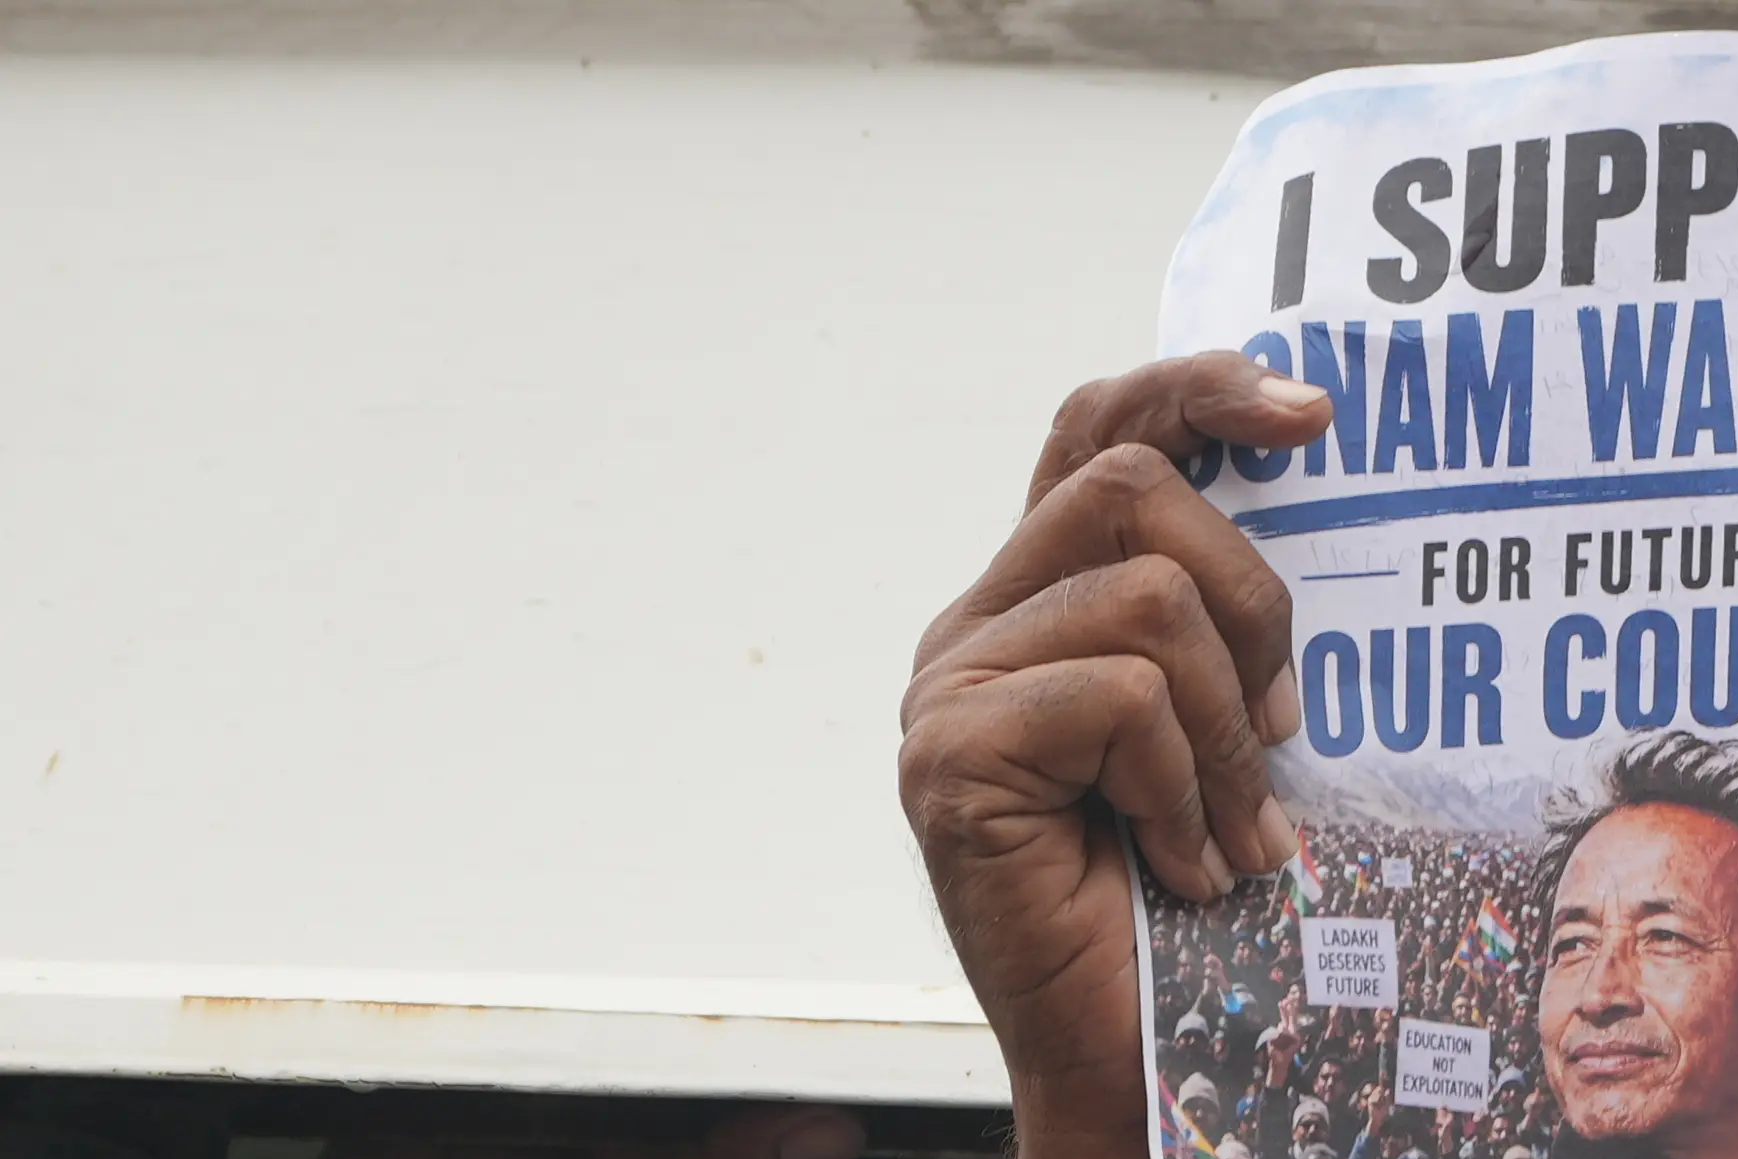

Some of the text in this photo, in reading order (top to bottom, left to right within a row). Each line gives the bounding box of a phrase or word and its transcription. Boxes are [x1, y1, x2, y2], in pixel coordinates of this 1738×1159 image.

[1271, 171, 1315, 311] I
[1191, 309, 1535, 492] ONAM
[1421, 538, 1531, 606] FOR
[1301, 623, 1505, 758] OUR
[1321, 928, 1379, 949] LADAKH
[1318, 953, 1386, 973] DESERVES
[1326, 976, 1380, 997] FUTURE
[1405, 1030, 1472, 1056] EDUCATION
[1432, 1057, 1457, 1074] NOT
[1402, 1073, 1484, 1100] EXPLOITATION
